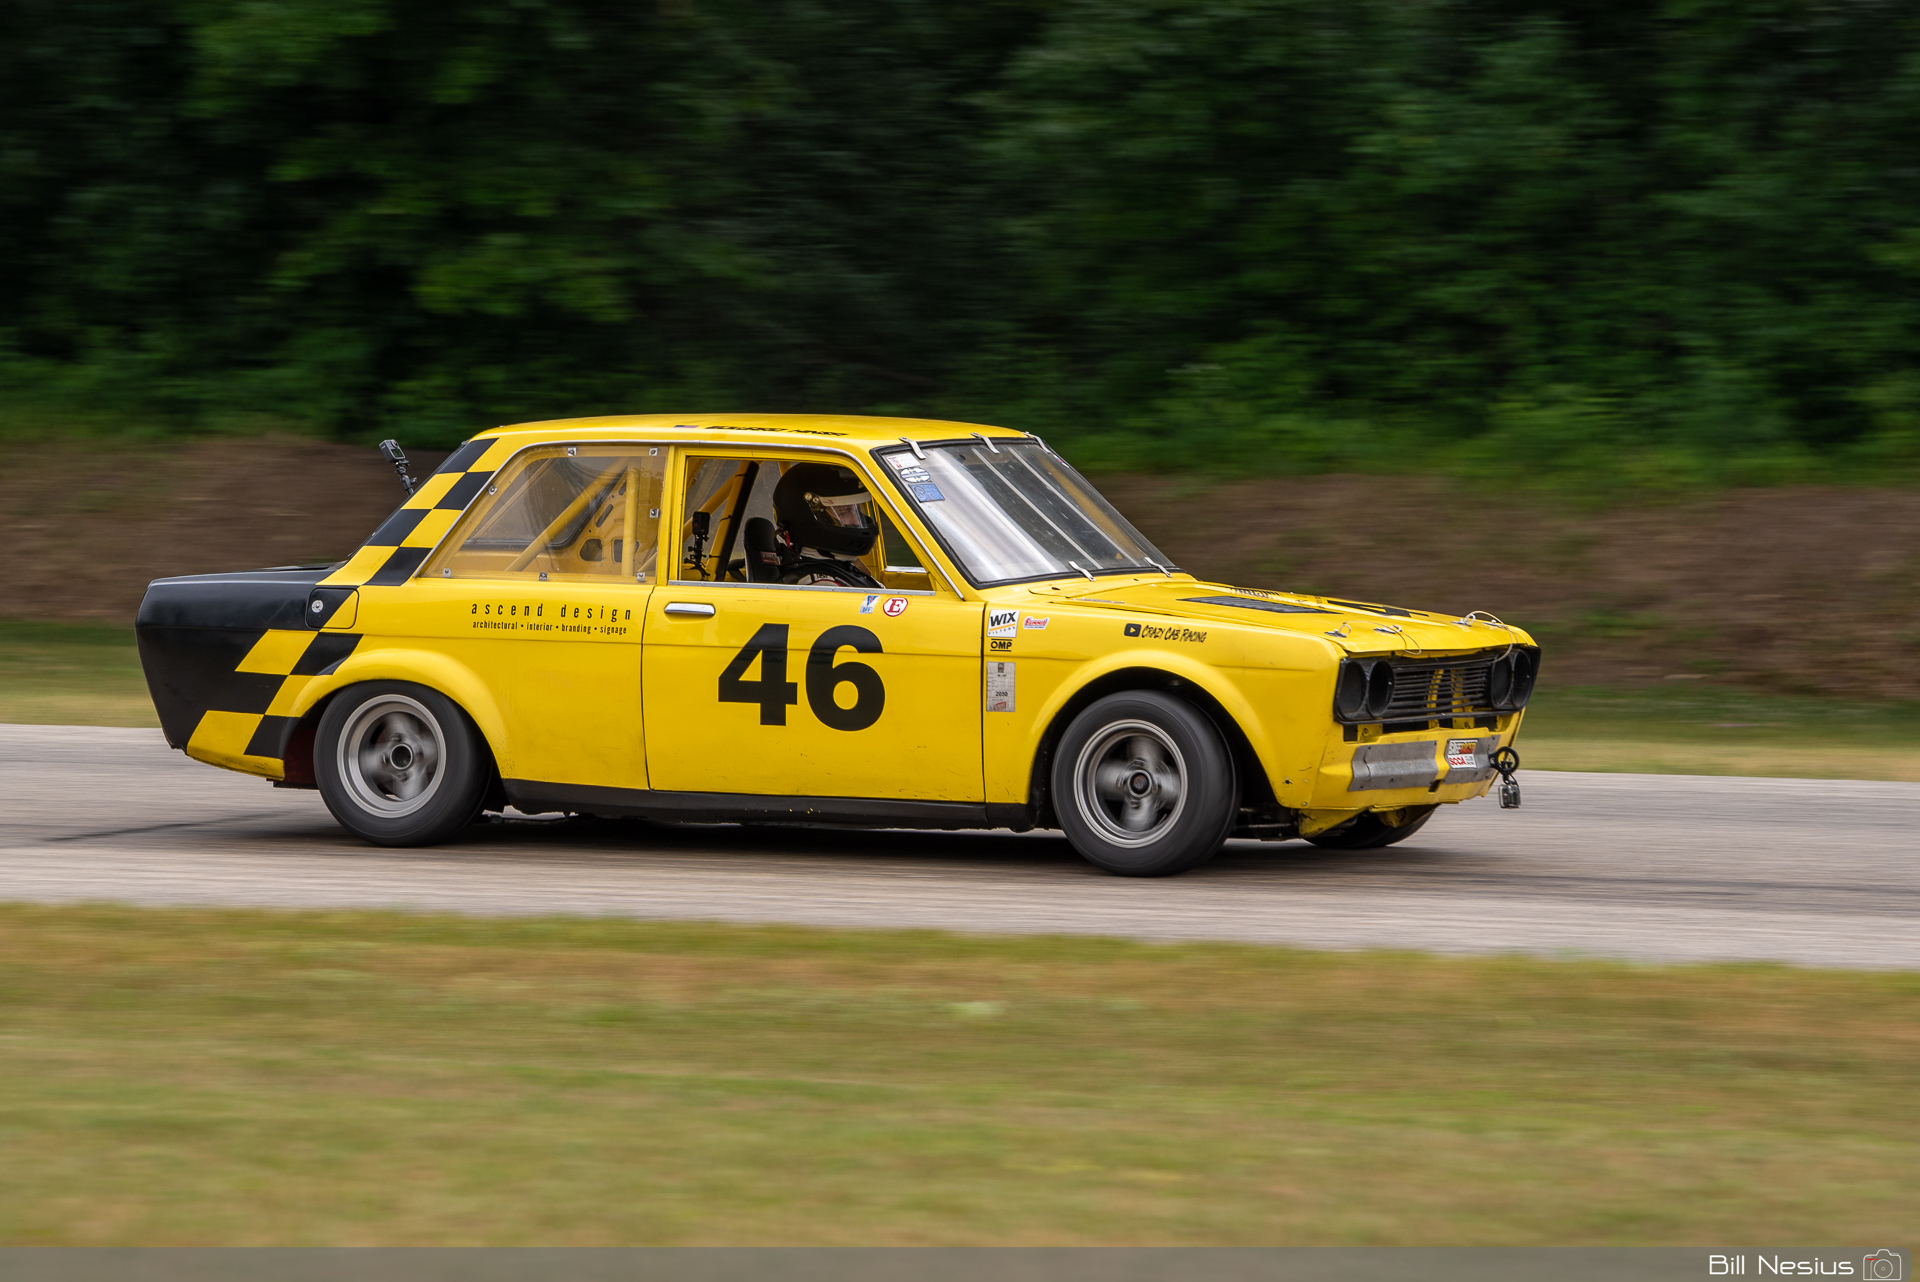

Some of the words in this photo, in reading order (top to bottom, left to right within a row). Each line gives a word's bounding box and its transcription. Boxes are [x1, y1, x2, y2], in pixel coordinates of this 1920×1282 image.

[471, 603, 543, 617] ascend
[560, 604, 631, 622] design
[990, 611, 1016, 627] WIX
[472, 620, 518, 630] architectural
[526, 622, 553, 631] interior
[561, 623, 591, 634] branding
[600, 625, 627, 635] signage
[990, 641, 1012, 649] OMP
[718, 623, 886, 731] 46
